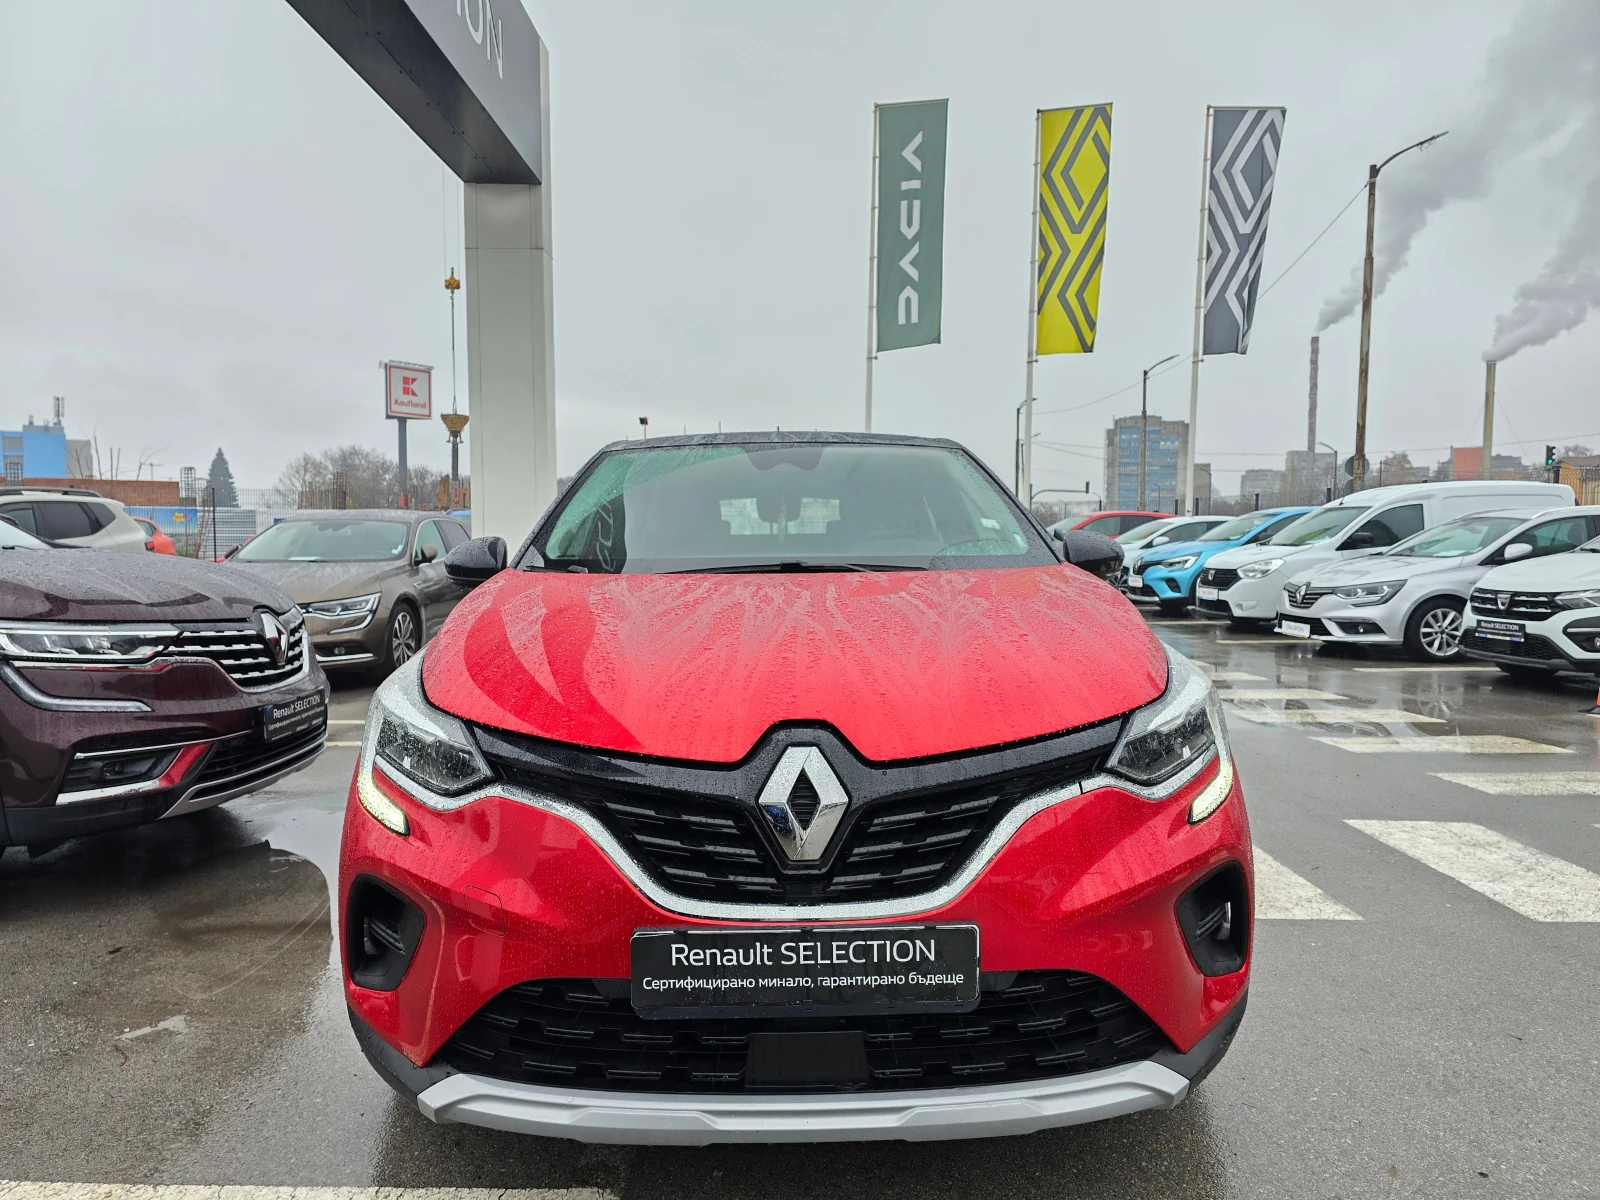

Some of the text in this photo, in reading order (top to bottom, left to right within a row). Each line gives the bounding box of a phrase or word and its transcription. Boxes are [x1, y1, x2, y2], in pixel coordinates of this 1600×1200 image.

[898, 130, 923, 325] DACIA
[394, 398, 427, 409] Kaufland
[273, 704, 294, 719] Renault
[295, 694, 320, 712] SELECTION
[670, 939, 936, 966] Renault SELECTION
[642, 972, 964, 992] Сертифицирано минало, гарантирано бъдеще
